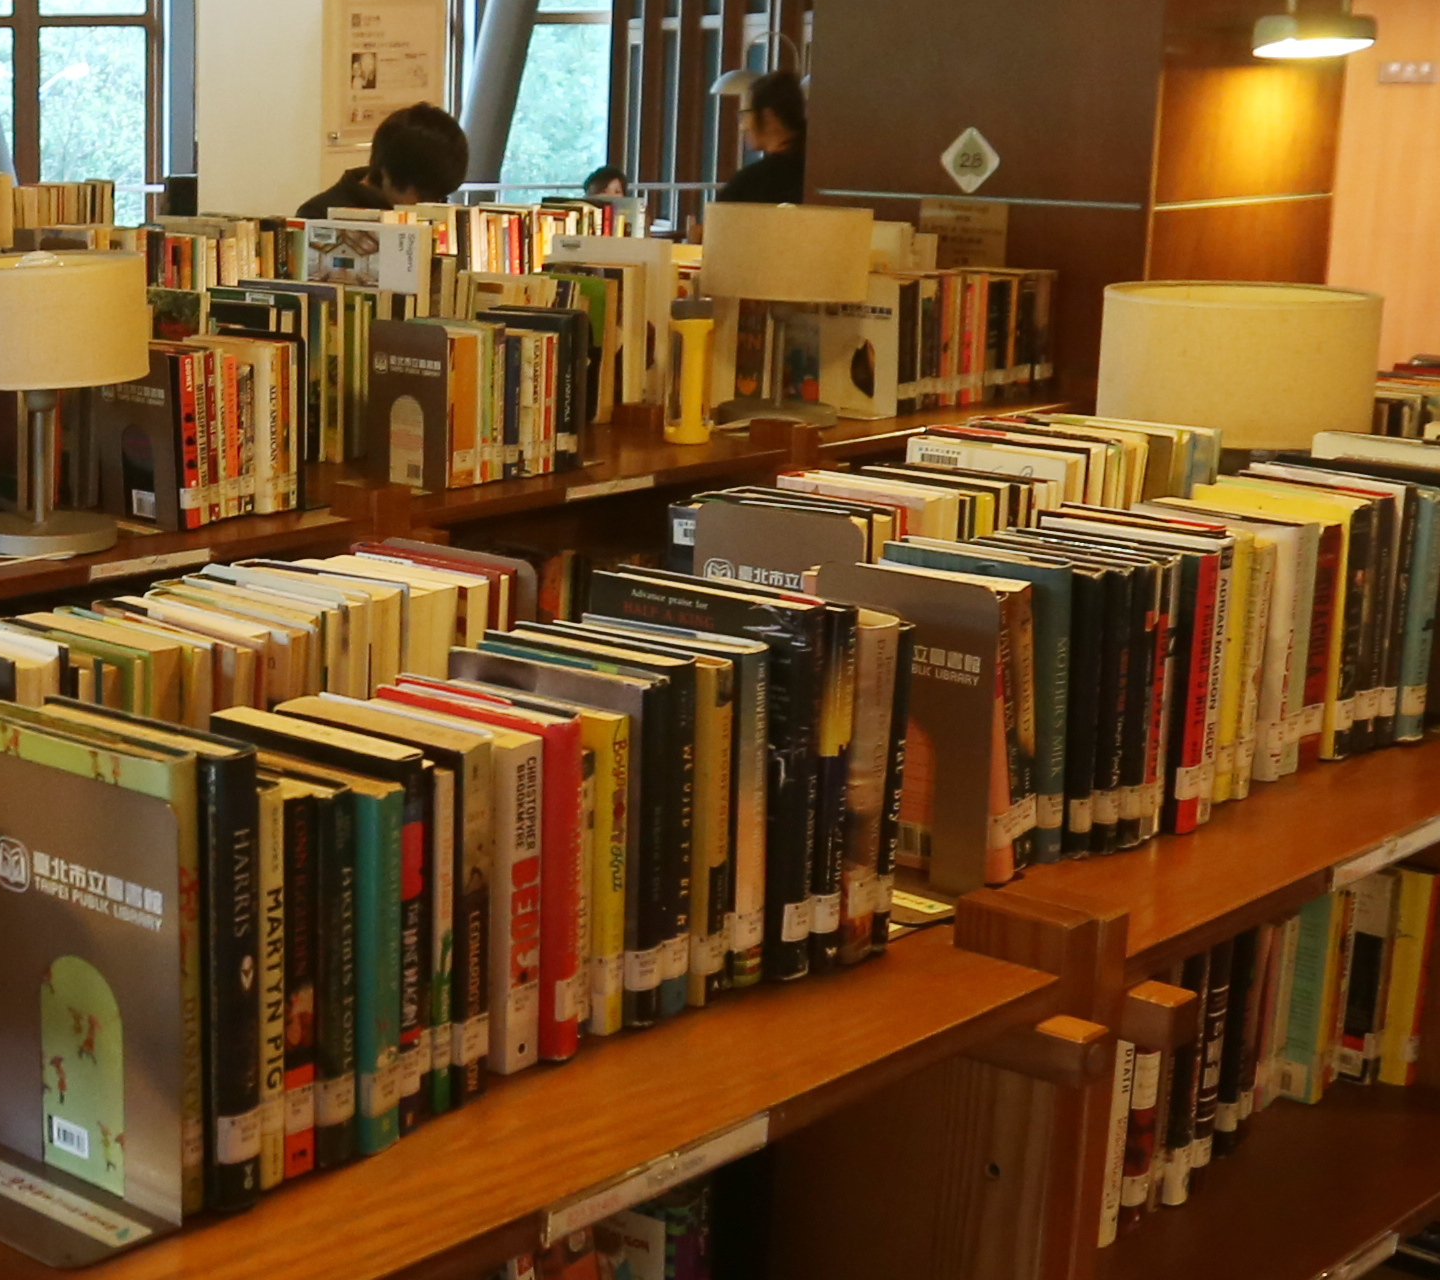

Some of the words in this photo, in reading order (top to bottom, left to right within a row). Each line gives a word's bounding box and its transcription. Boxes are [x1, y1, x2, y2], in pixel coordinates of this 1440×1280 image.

[406, 232, 415, 272] Shigeru
[183, 357, 192, 392] COONEY
[622, 601, 656, 617] HALF
[662, 610, 673, 620] A
[630, 588, 666, 602] Advance
[668, 596, 693, 608] praise
[694, 600, 708, 610] for
[1215, 577, 1226, 636] ADRIAN
[934, 666, 980, 686] LIBRARY
[1051, 636, 1068, 729] MOTHER'S
[1208, 640, 1222, 710] MAGSON
[754, 682, 766, 748] UNIVERSE
[1049, 734, 1065, 778] MILK
[515, 763, 524, 850] BROOKMYRE
[525, 755, 537, 851] CHRISTOPHER
[233, 827, 249, 939] HARRIS
[341, 865, 352, 986] ARTEMIS
[266, 886, 283, 1032] MARTYN
[265, 1035, 282, 1091] PIG
[343, 995, 355, 1070] FOWL
